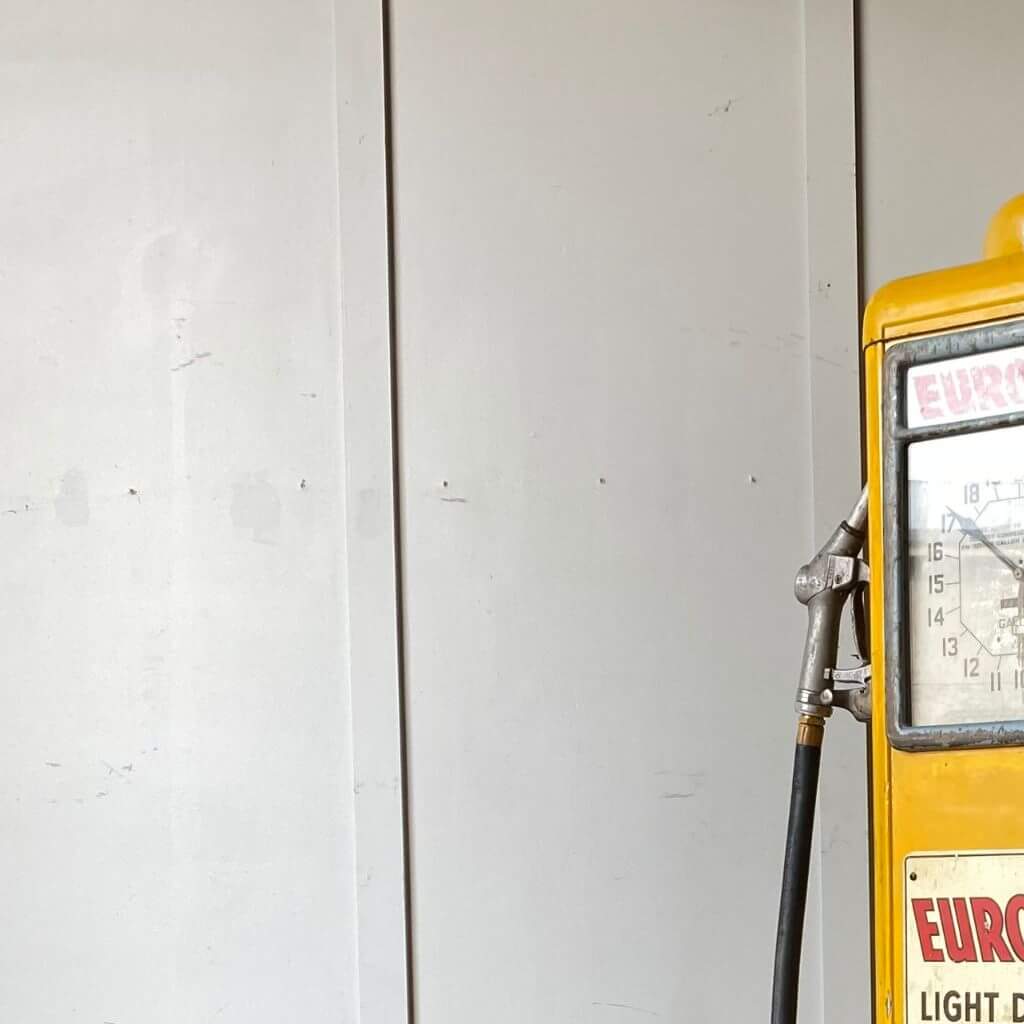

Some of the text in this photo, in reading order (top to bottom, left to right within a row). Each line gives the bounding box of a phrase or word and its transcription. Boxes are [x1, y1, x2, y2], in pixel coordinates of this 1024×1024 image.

[964, 483, 980, 505] 18
[928, 542, 943, 562] 16
[929, 574, 944, 594] 15
[928, 607, 944, 627] 14
[942, 637, 958, 656] 13
[964, 658, 979, 677] 12
[990, 671, 1001, 691] 11
[921, 990, 1000, 1023] LIGHT
